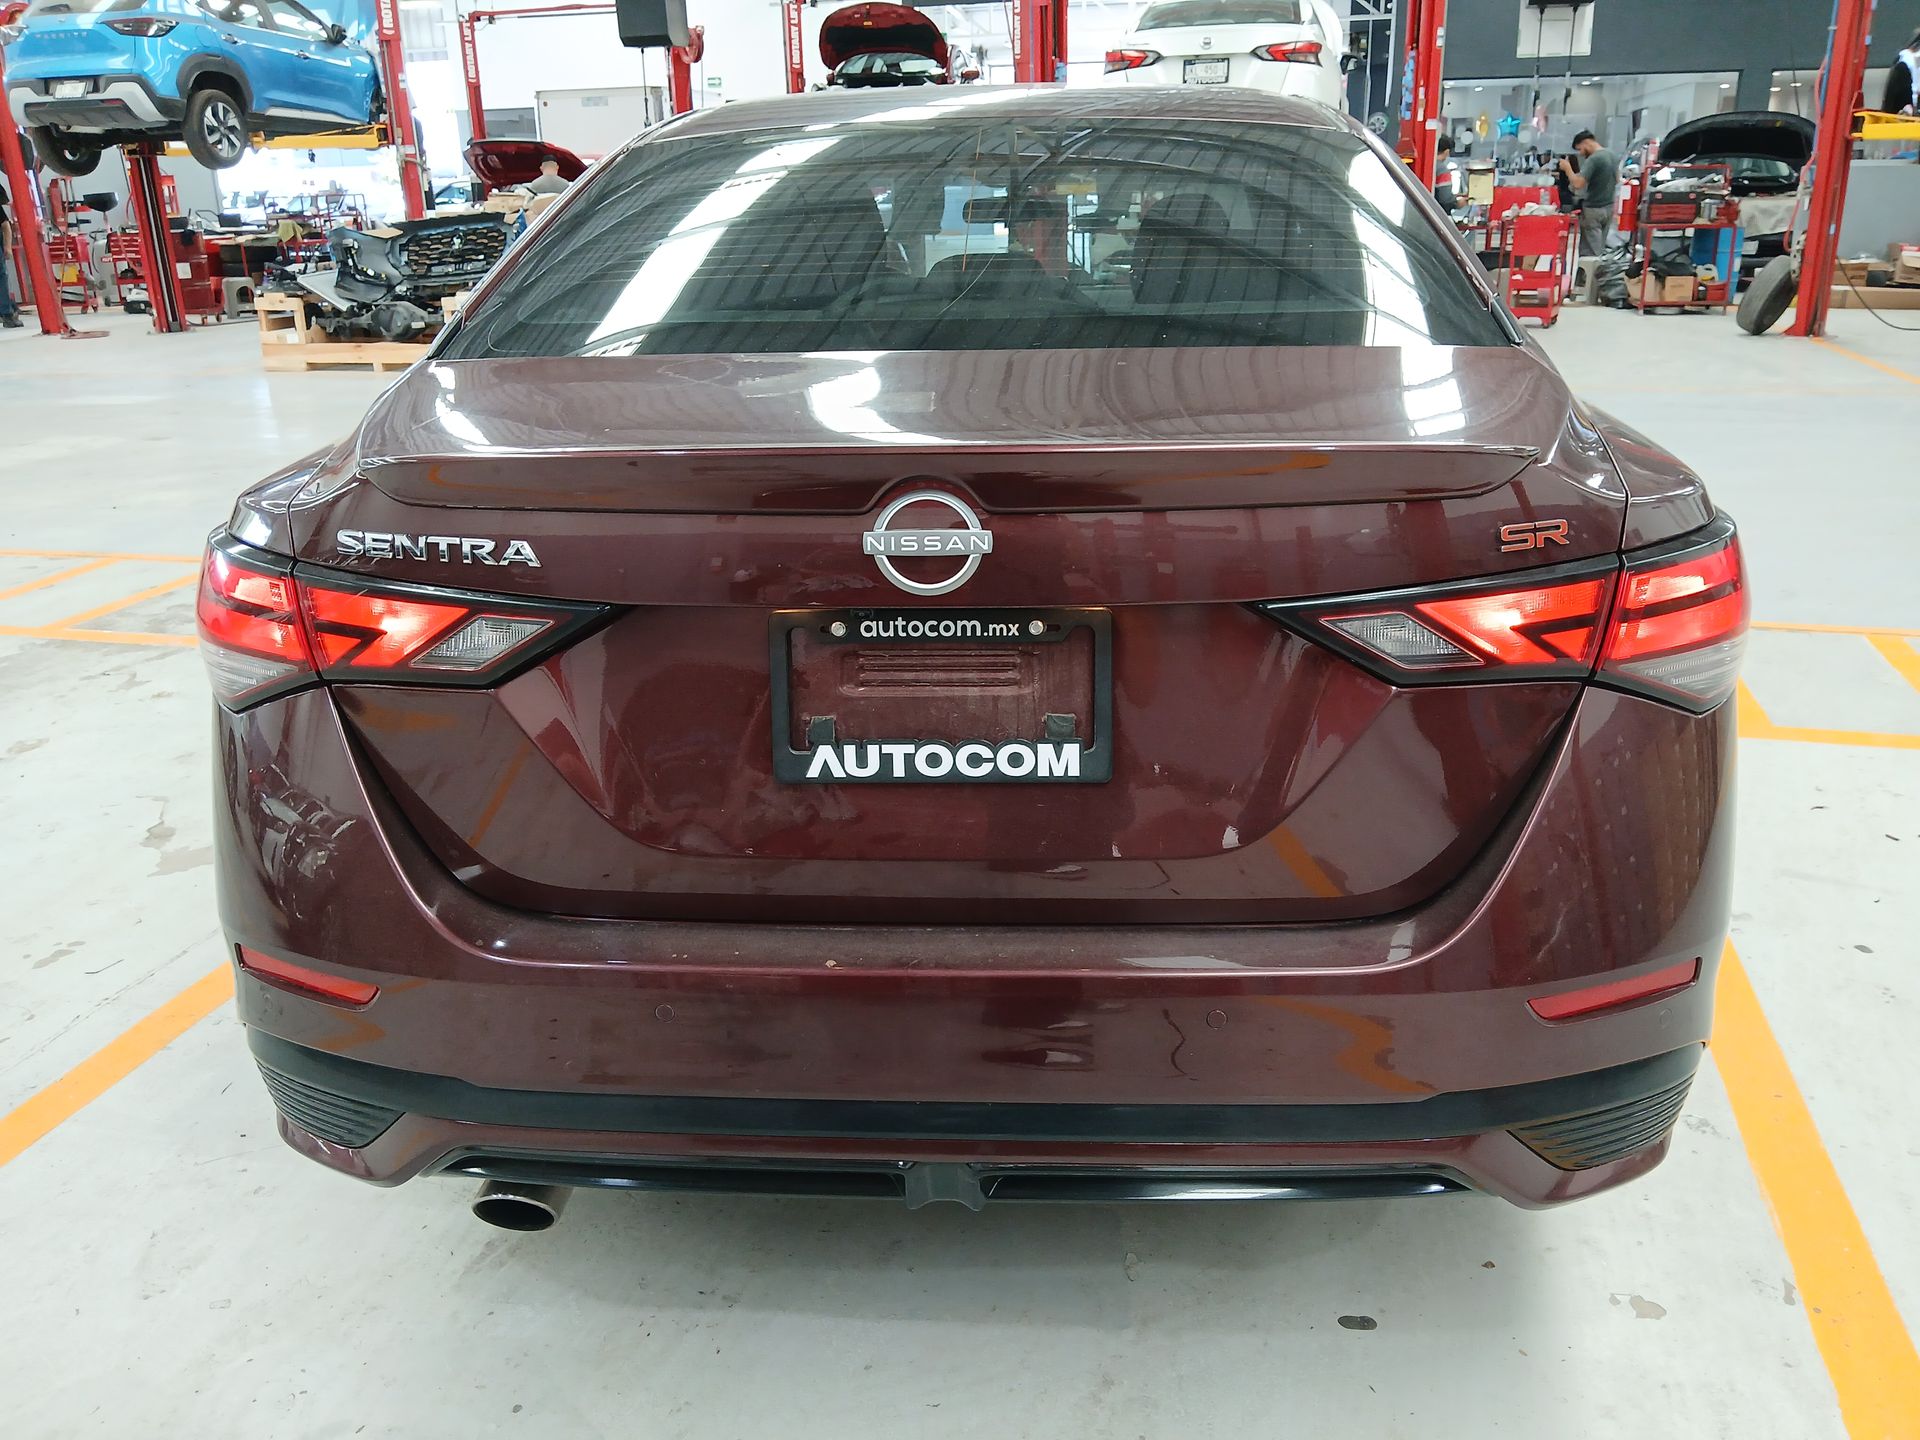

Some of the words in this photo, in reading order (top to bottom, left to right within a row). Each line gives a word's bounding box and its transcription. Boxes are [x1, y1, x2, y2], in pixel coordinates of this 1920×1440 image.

[336, 528, 543, 568] SENTRA
[866, 535, 989, 552] NISSAN
[1500, 518, 1570, 552] SR
[859, 616, 1020, 638] autocom.mx
[805, 743, 1081, 778] AUTOCOM
